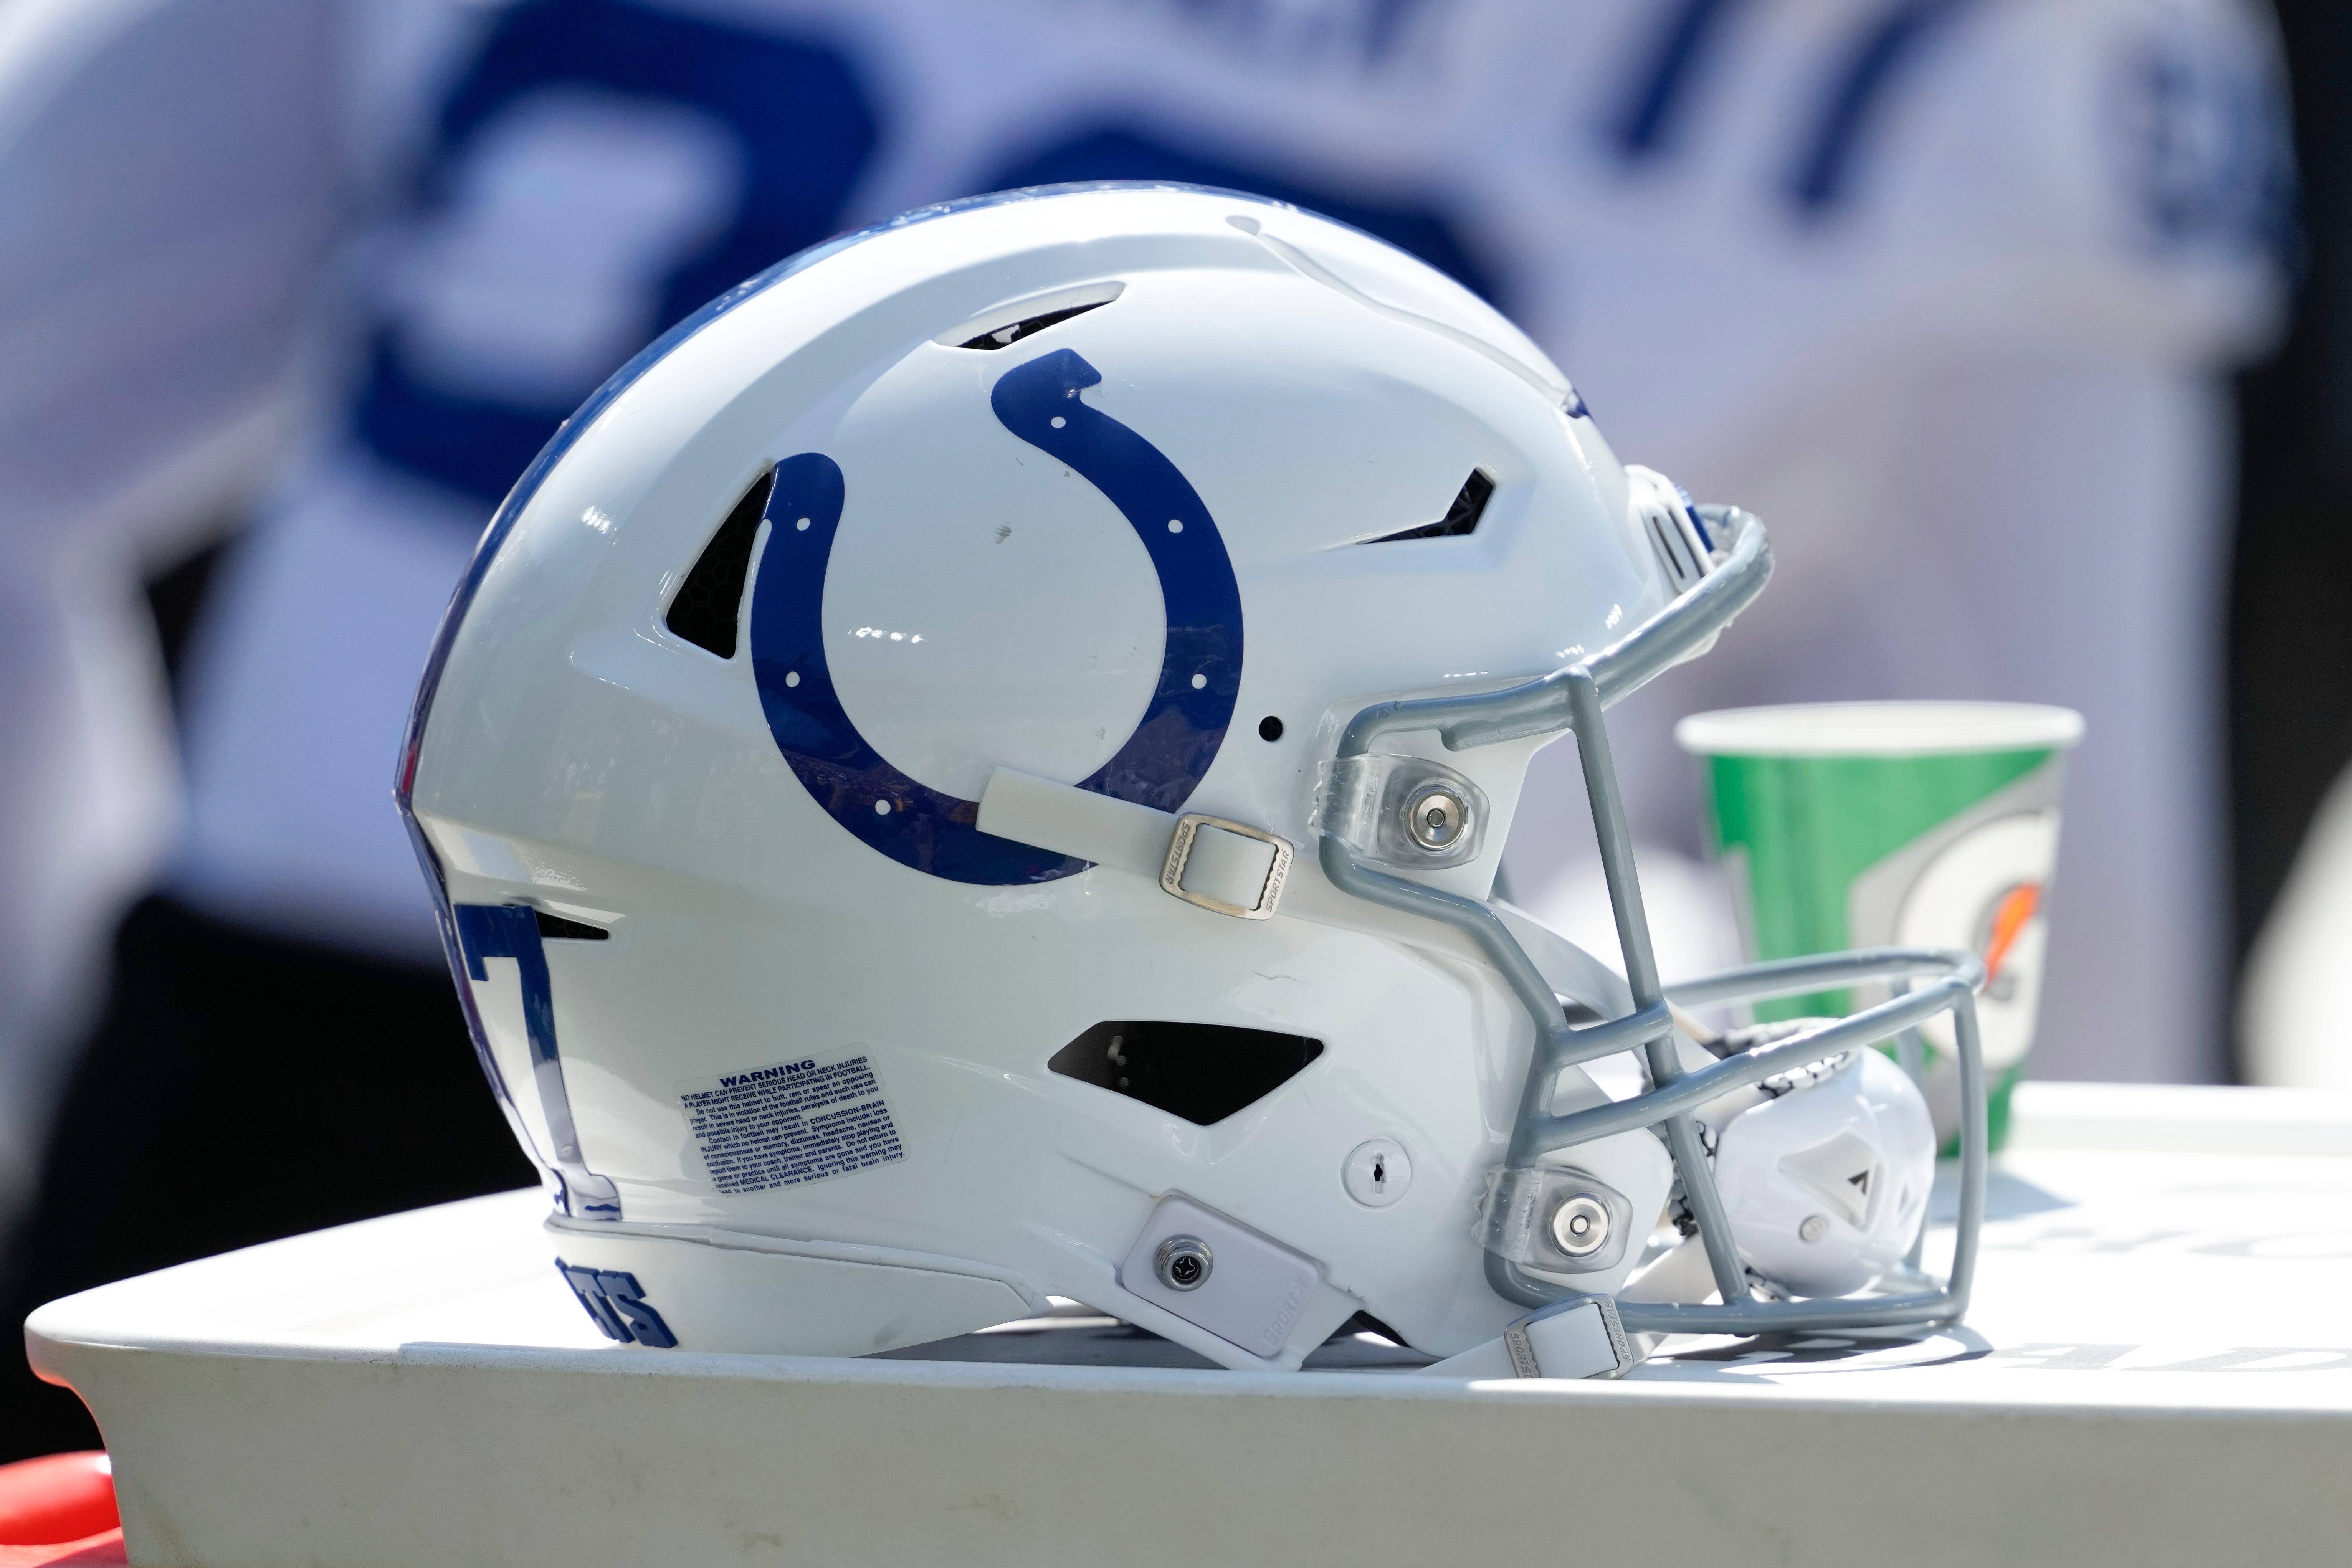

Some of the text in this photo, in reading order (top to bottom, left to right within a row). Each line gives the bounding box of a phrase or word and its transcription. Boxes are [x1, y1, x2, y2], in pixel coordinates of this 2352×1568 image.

[1167, 821, 1190, 885] SPORTSTAR
[1266, 849, 1290, 912] SPORTSTAR
[454, 903, 582, 1163] 7
[688, 1099, 711, 1108] PLAYER
[711, 1096, 729, 1105] MIGHT
[730, 1091, 757, 1101] RECEIVE
[756, 1087, 777, 1096] WHILE
[777, 1076, 825, 1092] PARTICIPATING
[832, 1064, 870, 1078] FOOTBALL.
[690, 1091, 714, 1100] HELMET
[728, 1083, 756, 1094] PREVENT
[757, 1077, 786, 1088] SERIOUS
[786, 1072, 805, 1082] HEAD
[817, 1064, 836, 1074] NECK
[836, 1056, 867, 1069] INJURIES
[719, 1059, 815, 1087] WARNING
[741, 1098, 763, 1107] helmet
[771, 1093, 787, 1101] butt,
[812, 1083, 829, 1092] spear
[841, 1072, 873, 1084] opposing
[708, 1135, 732, 1143] Contact
[740, 1129, 764, 1139] football
[781, 1121, 800, 1131] result
[810, 1099, 884, 1124] CONCUSSION-BRAIN
[734, 1116, 750, 1124] head
[759, 1112, 774, 1120] neck
[774, 1107, 800, 1117] injuries,
[800, 1099, 830, 1112] paralysis
[838, 1092, 857, 1101] death
[866, 1086, 879, 1095] you
[735, 1107, 761, 1116] violation
[779, 1097, 803, 1107] football
[803, 1092, 820, 1102] rules
[821, 1089, 833, 1098] and
[834, 1084, 850, 1094] such
[700, 1144, 722, 1152] INJURY
[723, 1141, 740, 1149] which
[749, 1136, 771, 1145] helmet
[783, 1128, 809, 1140] prevent.
[811, 1119, 845, 1132] Symptoms
[846, 1112, 873, 1123] include:
[873, 1108, 888, 1116] loss
[706, 1128, 731, 1137] possible
[755, 1121, 770, 1129] your
[771, 1114, 802, 1125] opponent.
[711, 1148, 754, 1158] consciousness
[762, 1141, 789, 1150] memory,
[790, 1132, 822, 1144] dizziness,
[822, 1125, 856, 1137] headache,
[857, 1118, 881, 1128] nausea
[769, 1147, 802, 1158] symptoms,
[802, 1136, 840, 1150] immediately
[856, 1126, 880, 1138] playing
[881, 1121, 893, 1130] and
[715, 1180, 739, 1188] received
[739, 1175, 769, 1185] MEDICAL
[770, 1166, 815, 1180] CLEARANCE.
[817, 1158, 845, 1171] Ignoring
[859, 1148, 886, 1159] warning
[888, 1144, 901, 1152] may
[741, 1169, 765, 1178] practice
[766, 1165, 780, 1173] until
[790, 1155, 823, 1169] symptoms
[836, 1149, 853, 1158] gone
[855, 1144, 867, 1153] and
[868, 1142, 881, 1150] you
[882, 1137, 899, 1145] have
[763, 1157, 783, 1166] coach,
[783, 1153, 803, 1162] trainer
[804, 1149, 817, 1157] and
[817, 1142, 843, 1155] parents.
[845, 1139, 855, 1147] Do
[867, 1132, 888, 1141] return
[803, 1170, 829, 1181] serious
[842, 1162, 858, 1171] fatal
[860, 1158, 879, 1167] brain
[882, 1152, 905, 1161] injury.
[1604, 1301, 1631, 1360] SPORTSTAR
[1510, 1332, 1535, 1379] SPORTST
